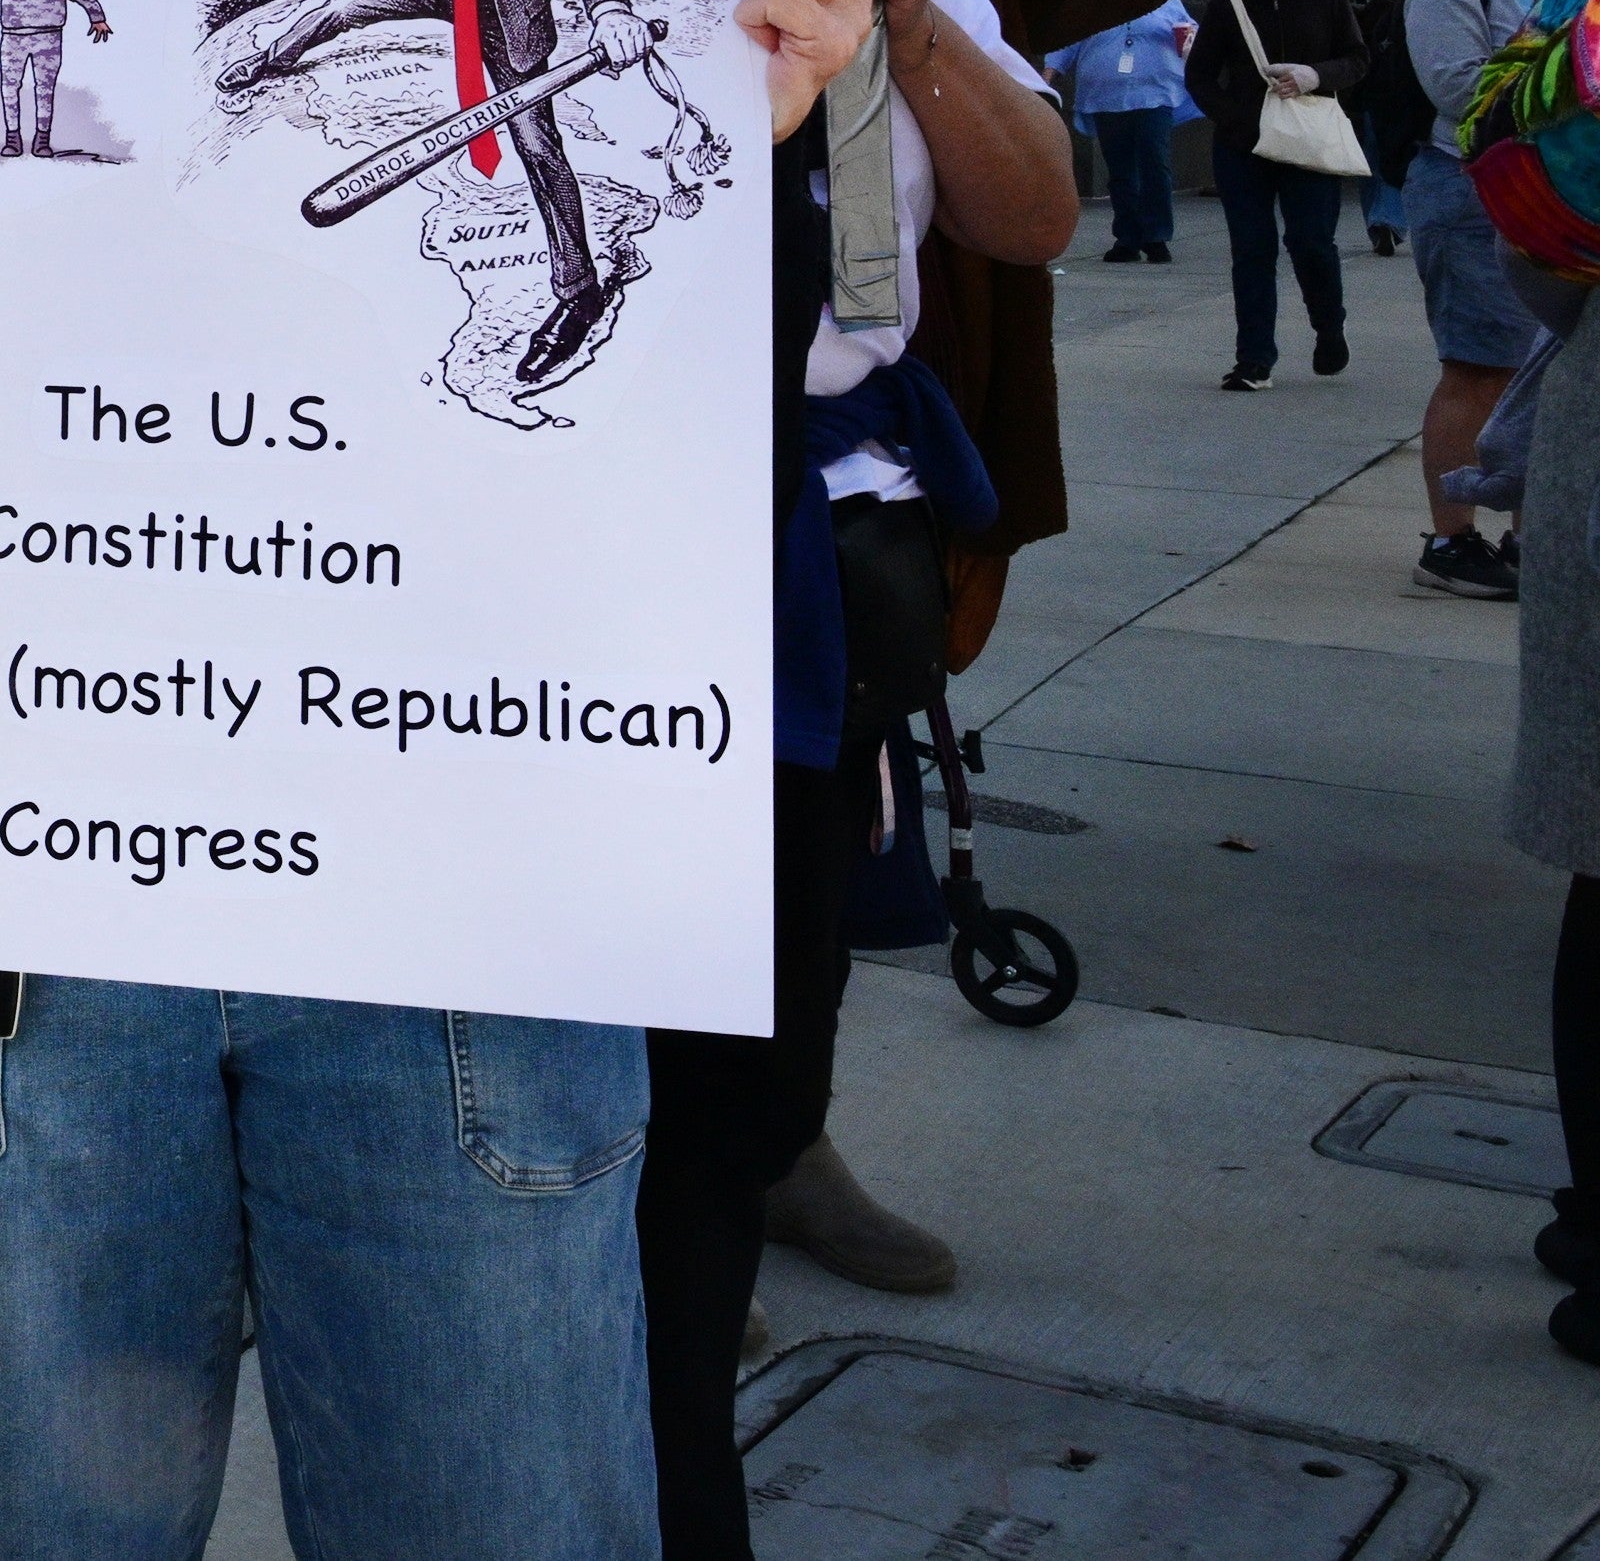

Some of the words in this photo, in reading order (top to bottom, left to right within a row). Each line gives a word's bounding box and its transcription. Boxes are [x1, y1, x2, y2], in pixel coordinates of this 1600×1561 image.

[344, 61, 434, 85] AMERICA
[335, 149, 415, 201] DONROE
[421, 91, 525, 154] DOCTRINE
[447, 219, 531, 244] SOUTH
[459, 250, 548, 273] AMERIC
[45, 385, 171, 443] The
[212, 392, 346, 451] U.S.
[9, 644, 261, 737] (mostly
[298, 666, 730, 764] Republican)
[0, 802, 318, 886] Congress
